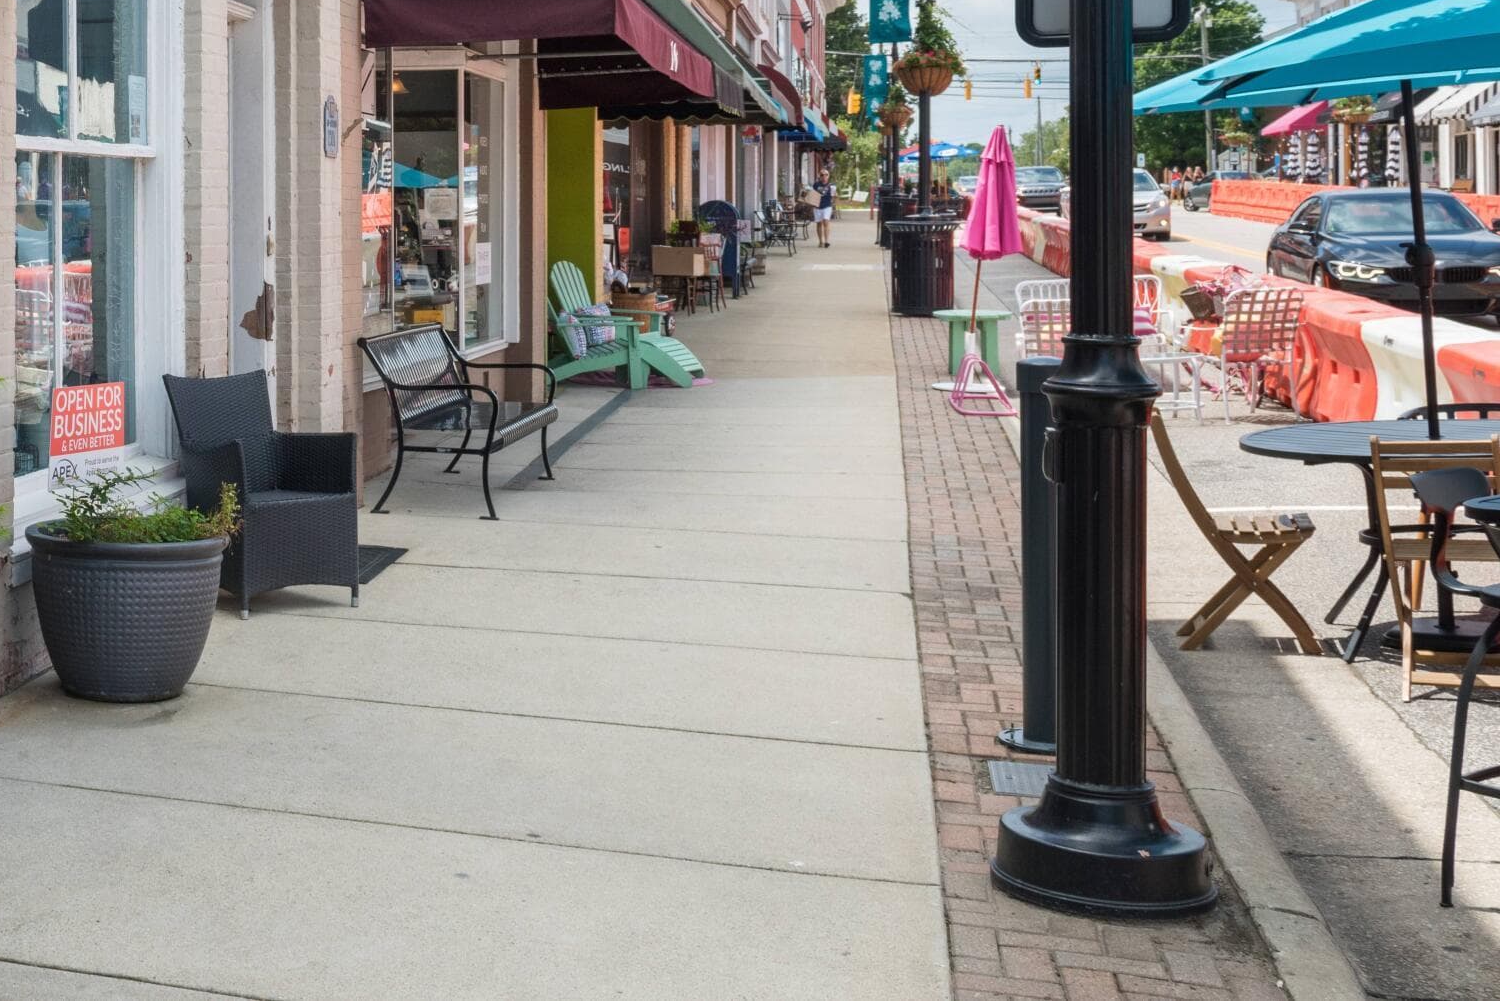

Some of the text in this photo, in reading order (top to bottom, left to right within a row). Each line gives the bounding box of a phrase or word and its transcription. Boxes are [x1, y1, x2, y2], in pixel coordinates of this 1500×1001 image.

[56, 385, 121, 412] OPEN FOR
[54, 409, 122, 439] BUSINESS
[61, 434, 115, 452] & EVEN BETTER
[52, 463, 78, 479] APEX
